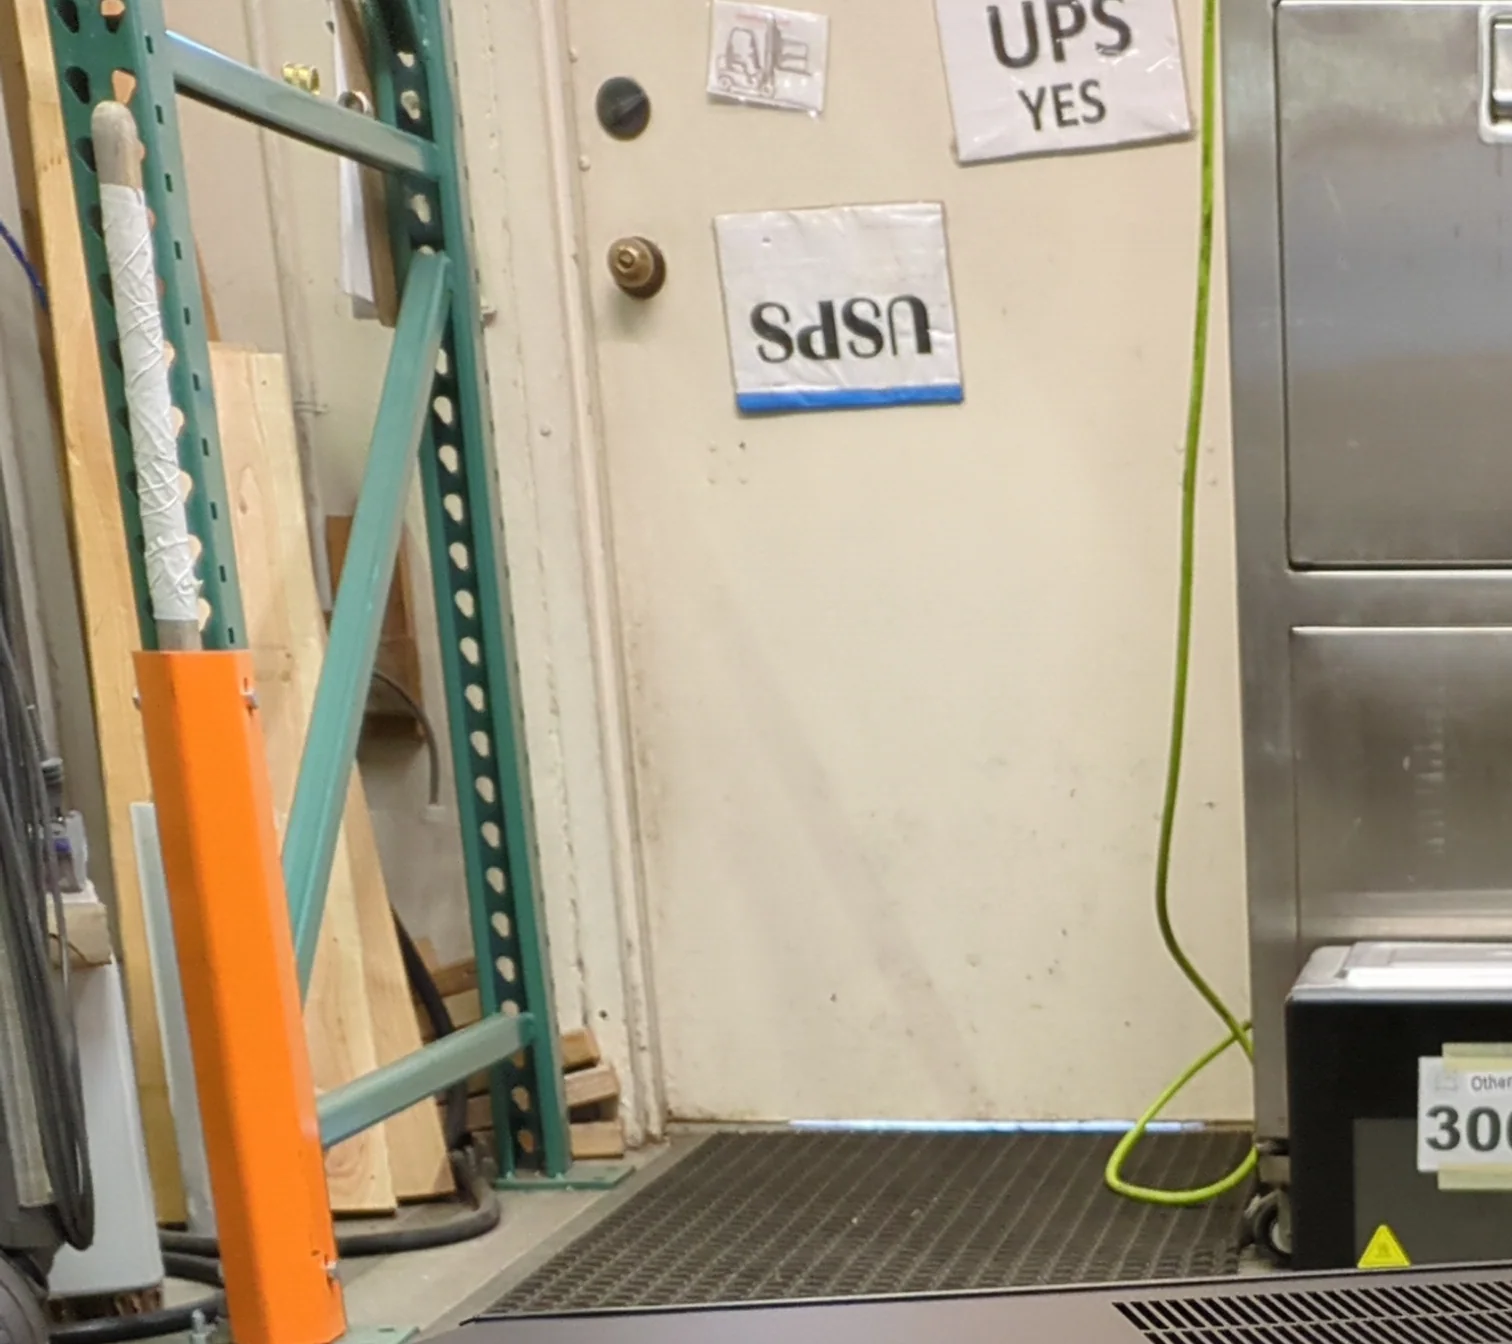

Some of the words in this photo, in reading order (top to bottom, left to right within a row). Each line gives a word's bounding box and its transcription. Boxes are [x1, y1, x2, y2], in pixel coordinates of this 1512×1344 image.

[987, 0, 1133, 69] UPS
[1017, 79, 1107, 132] YES
[750, 293, 933, 365] USPS
